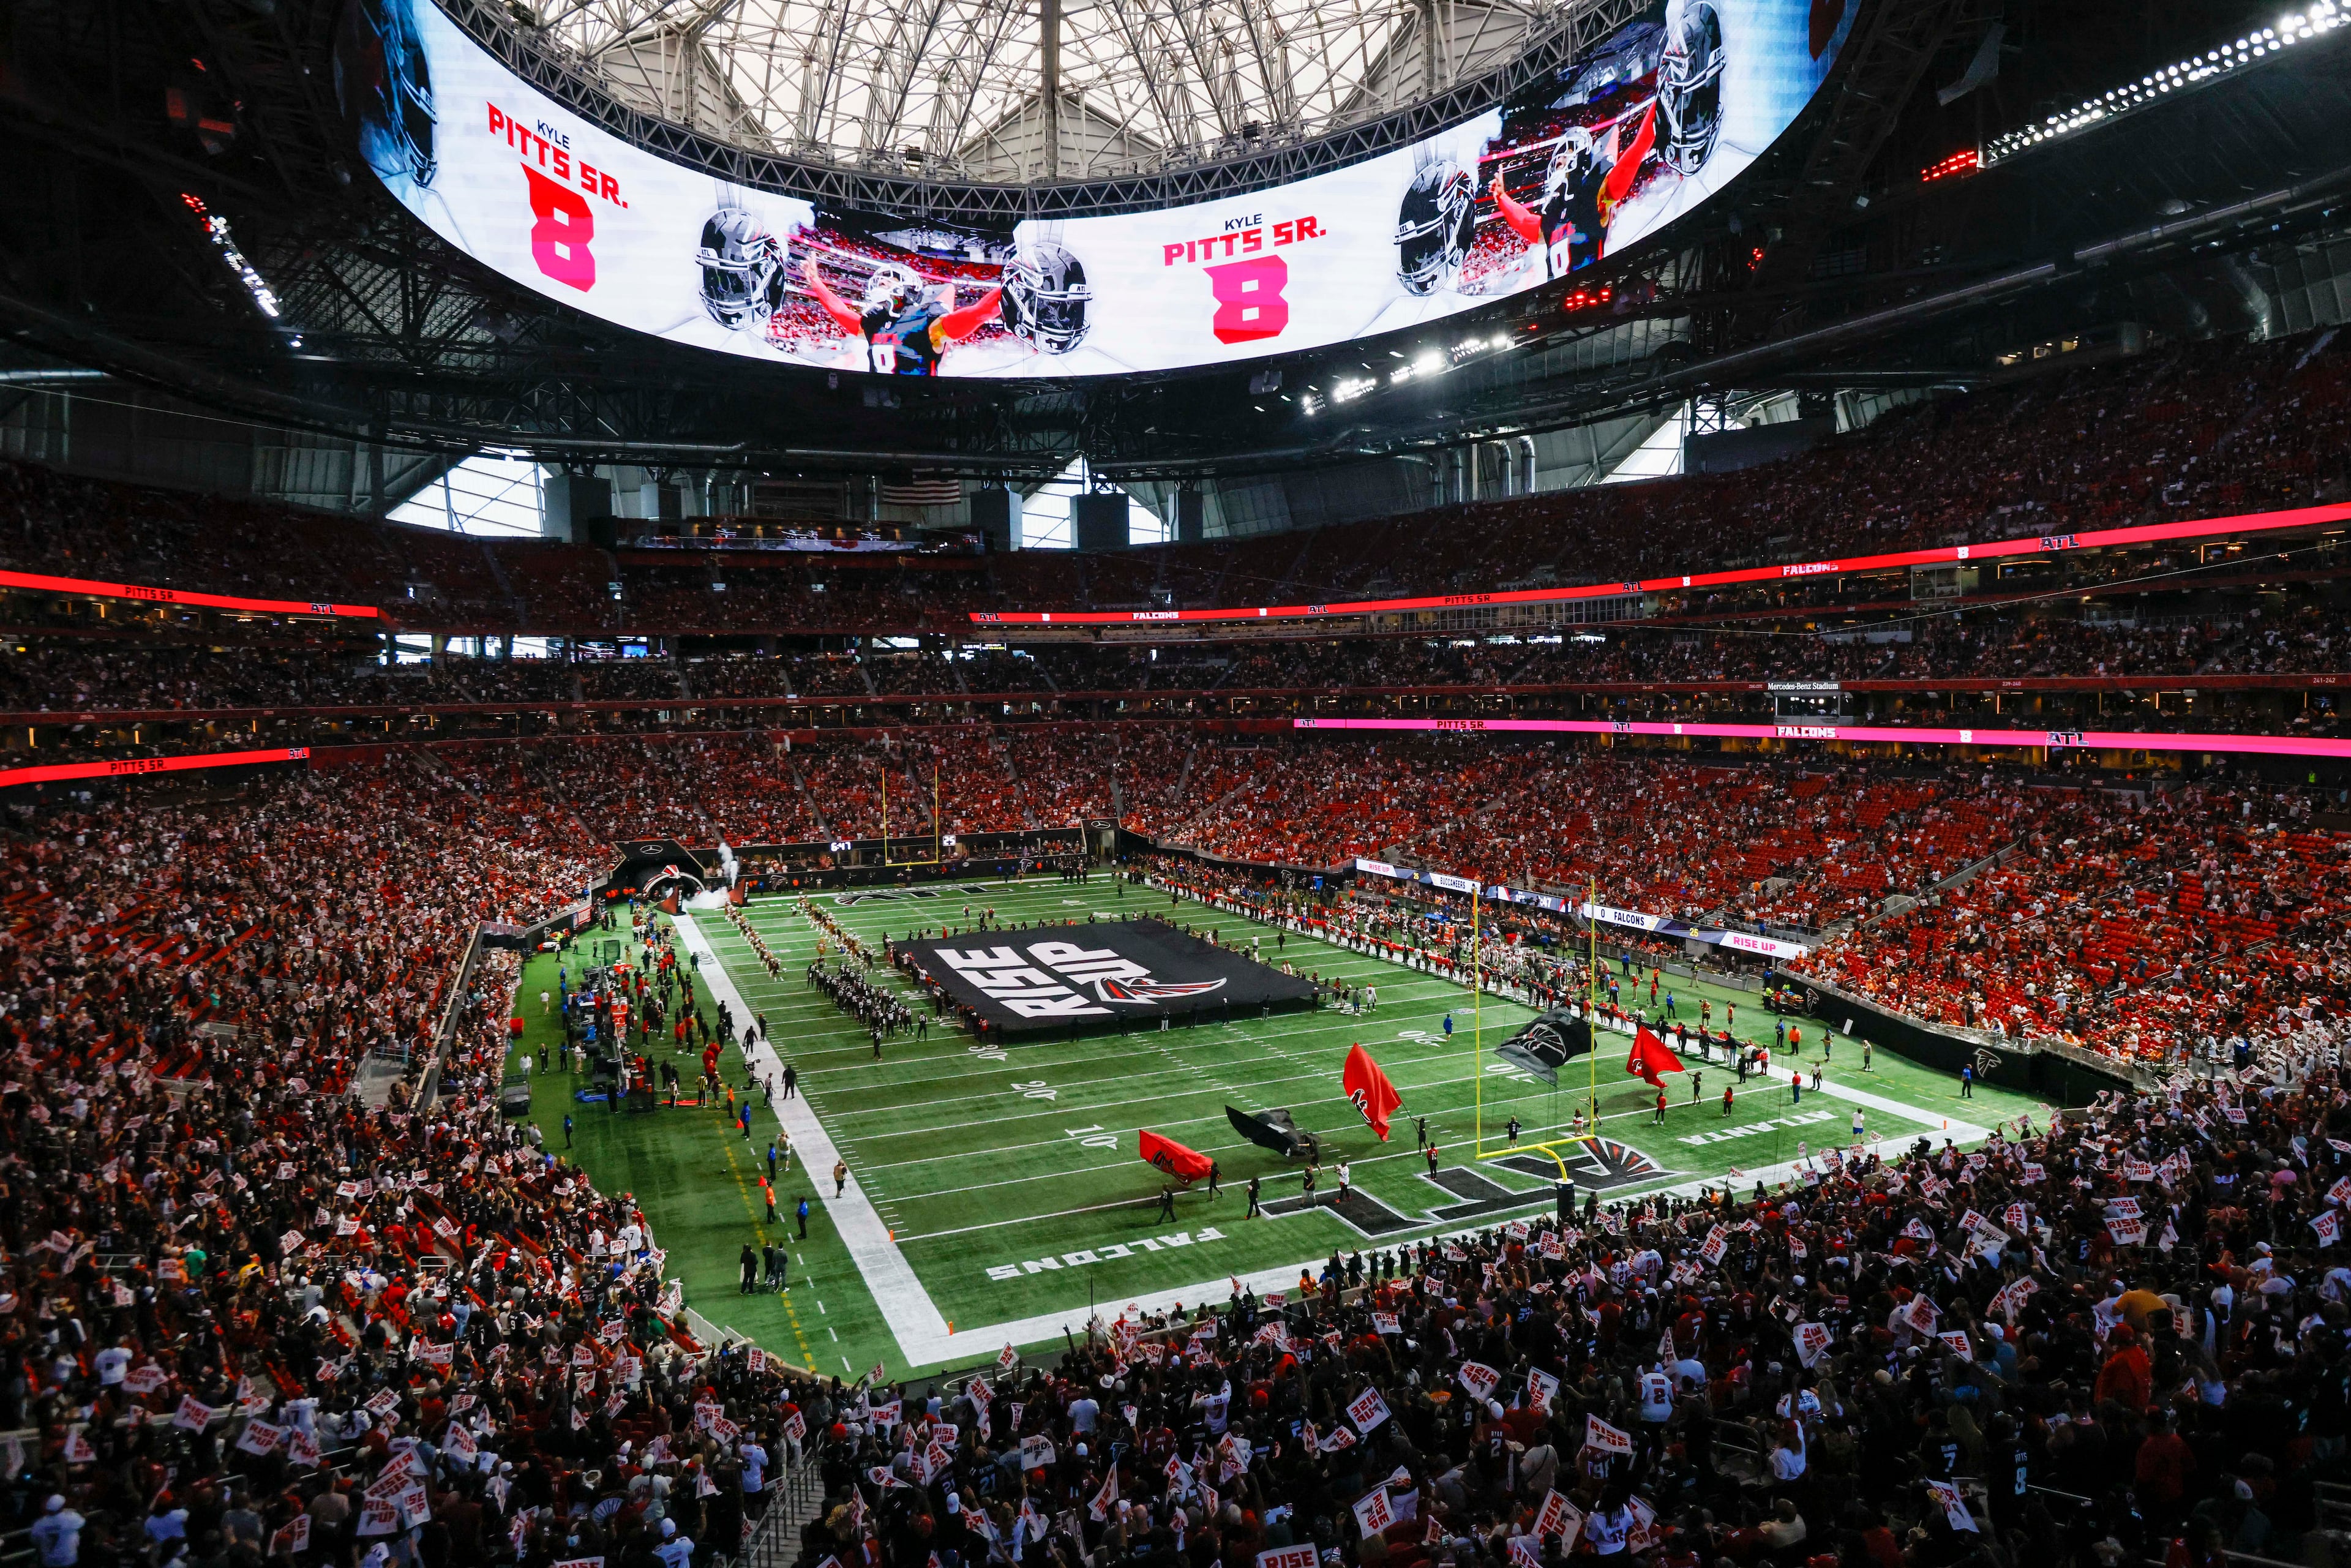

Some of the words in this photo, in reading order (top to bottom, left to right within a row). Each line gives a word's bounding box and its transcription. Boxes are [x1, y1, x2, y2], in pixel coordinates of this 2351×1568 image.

[538, 119, 569, 150] KYLE
[487, 102, 570, 180] PITTS
[579, 160, 628, 209] SR.
[521, 162, 596, 293] 8
[1224, 213, 1262, 230] KYLE
[1163, 228, 1262, 266] PITTS
[1272, 216, 1327, 244] SR.
[1202, 255, 1288, 344] 8
[2039, 534, 2080, 551] ATL
[1956, 546, 1969, 559] 8
[1782, 563, 1839, 576] FALCONS
[1622, 581, 1644, 593] ATL
[1682, 576, 1690, 587] 8
[124, 586, 156, 599] PITTS
[159, 590, 176, 601] SR.
[1445, 596, 1473, 604] PITTS
[1477, 595, 1493, 603] SR.
[310, 602, 336, 614] ATL
[1308, 605, 1328, 614] ATL
[978, 613, 1001, 621] ATL
[1813, 681, 1839, 690] Stadium
[1776, 727, 1836, 737] FALCONS
[1959, 730, 1972, 743] 8
[2046, 731, 2089, 746] ATL
[110, 761, 144, 773] PITTS
[148, 759, 166, 770] SR.
[1440, 877, 1465, 889] BUCCANEERS
[1601, 909, 1605, 918] 0
[1614, 912, 1644, 926] FALCONS
[1690, 928, 1699, 937] 25
[1733, 936, 1758, 949] RISE
[1761, 942, 1776, 952] UP
[1027, 941, 1152, 986] UP
[935, 946, 1114, 1018] RISE
[1484, 1064, 1534, 1082] 10
[1011, 1080, 1057, 1099] 20
[1677, 1109, 1839, 1145] ATLANTA
[1065, 1124, 1117, 1148] 10
[2107, 1218, 2139, 1230] RISE
[2125, 1226, 2142, 1235] UP
[630, 1232, 635, 1241] 7
[1540, 1232, 1550, 1252] RISE
[986, 1227, 1227, 1280] FALCONS
[1646, 1259, 1657, 1274] 21
[1618, 1271, 1630, 1285] 21
[583, 1294, 595, 1304] 32
[1578, 1291, 1586, 1303] 11
[1517, 1311, 1529, 1323] 27
[510, 1319, 516, 1331] 9
[1694, 1325, 1701, 1340] 7
[2270, 1325, 2282, 1348] 7
[575, 1347, 591, 1356] RISE
[1299, 1349, 1312, 1364] 24
[368, 1390, 390, 1409] RISE
[382, 1394, 396, 1406] UP
[1654, 1387, 1665, 1404] 2
[1213, 1403, 1224, 1419] 7
[249, 1423, 280, 1439] RISE
[794, 1415, 806, 1436] RISE
[1590, 1420, 1627, 1443] RISE
[256, 1436, 272, 1447] UP
[451, 1427, 475, 1446] RISE
[792, 1428, 800, 1441] UP
[1607, 1437, 1628, 1447] UP
[460, 1439, 474, 1454] UP
[1491, 1438, 1502, 1458] 2
[1943, 1452, 1956, 1472] 7
[369, 1472, 403, 1496] RISE
[389, 1479, 408, 1495] UP
[943, 1477, 955, 1494] 21
[979, 1474, 997, 1495] 21
[2015, 1467, 2028, 1495] 8
[1373, 1492, 1390, 1524] RISE
[378, 1511, 396, 1523] UP
[1368, 1512, 1379, 1531] UP
[1264, 1550, 1315, 1568] RISE
